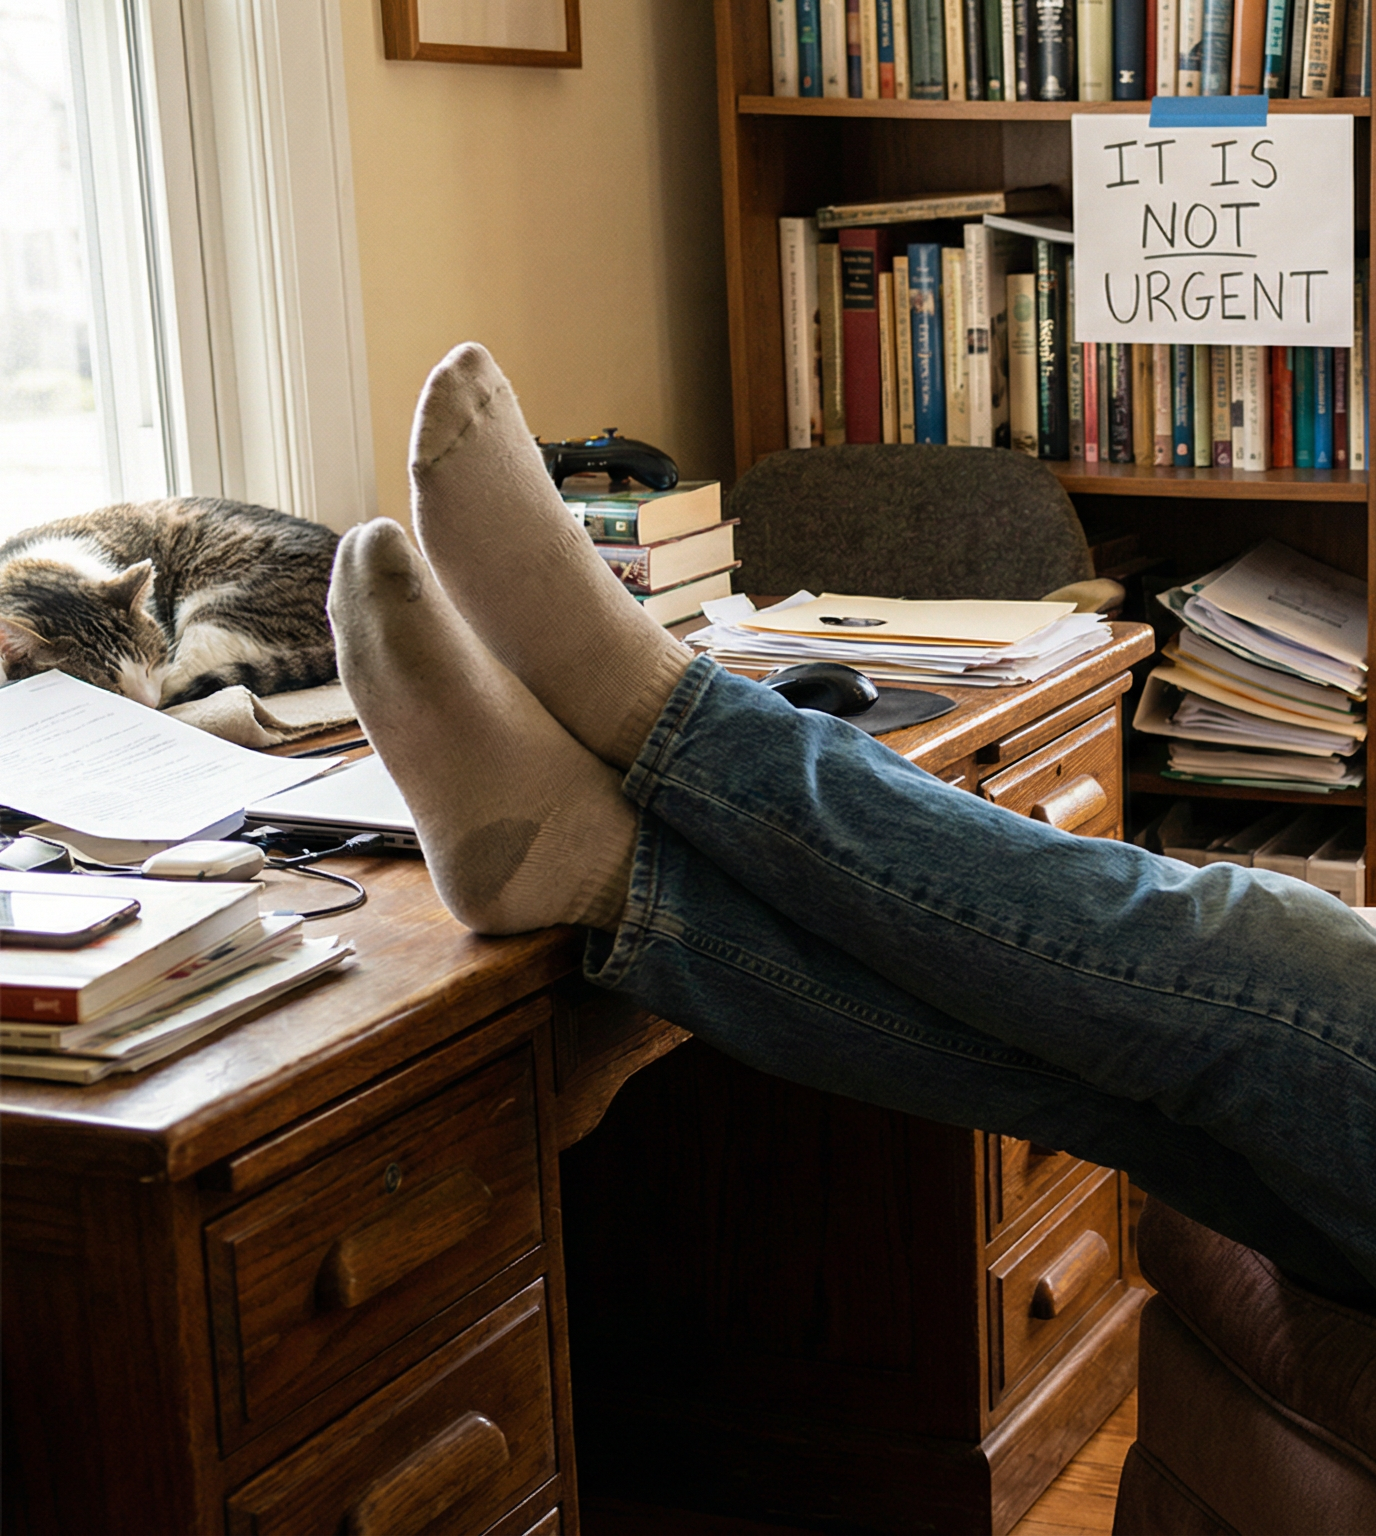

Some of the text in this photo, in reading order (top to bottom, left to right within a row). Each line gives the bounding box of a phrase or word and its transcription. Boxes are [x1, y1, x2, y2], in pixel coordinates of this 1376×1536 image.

[1104, 139, 1278, 189] IT IS
[1142, 202, 1260, 249] NOT
[1104, 270, 1329, 324] URGENT
